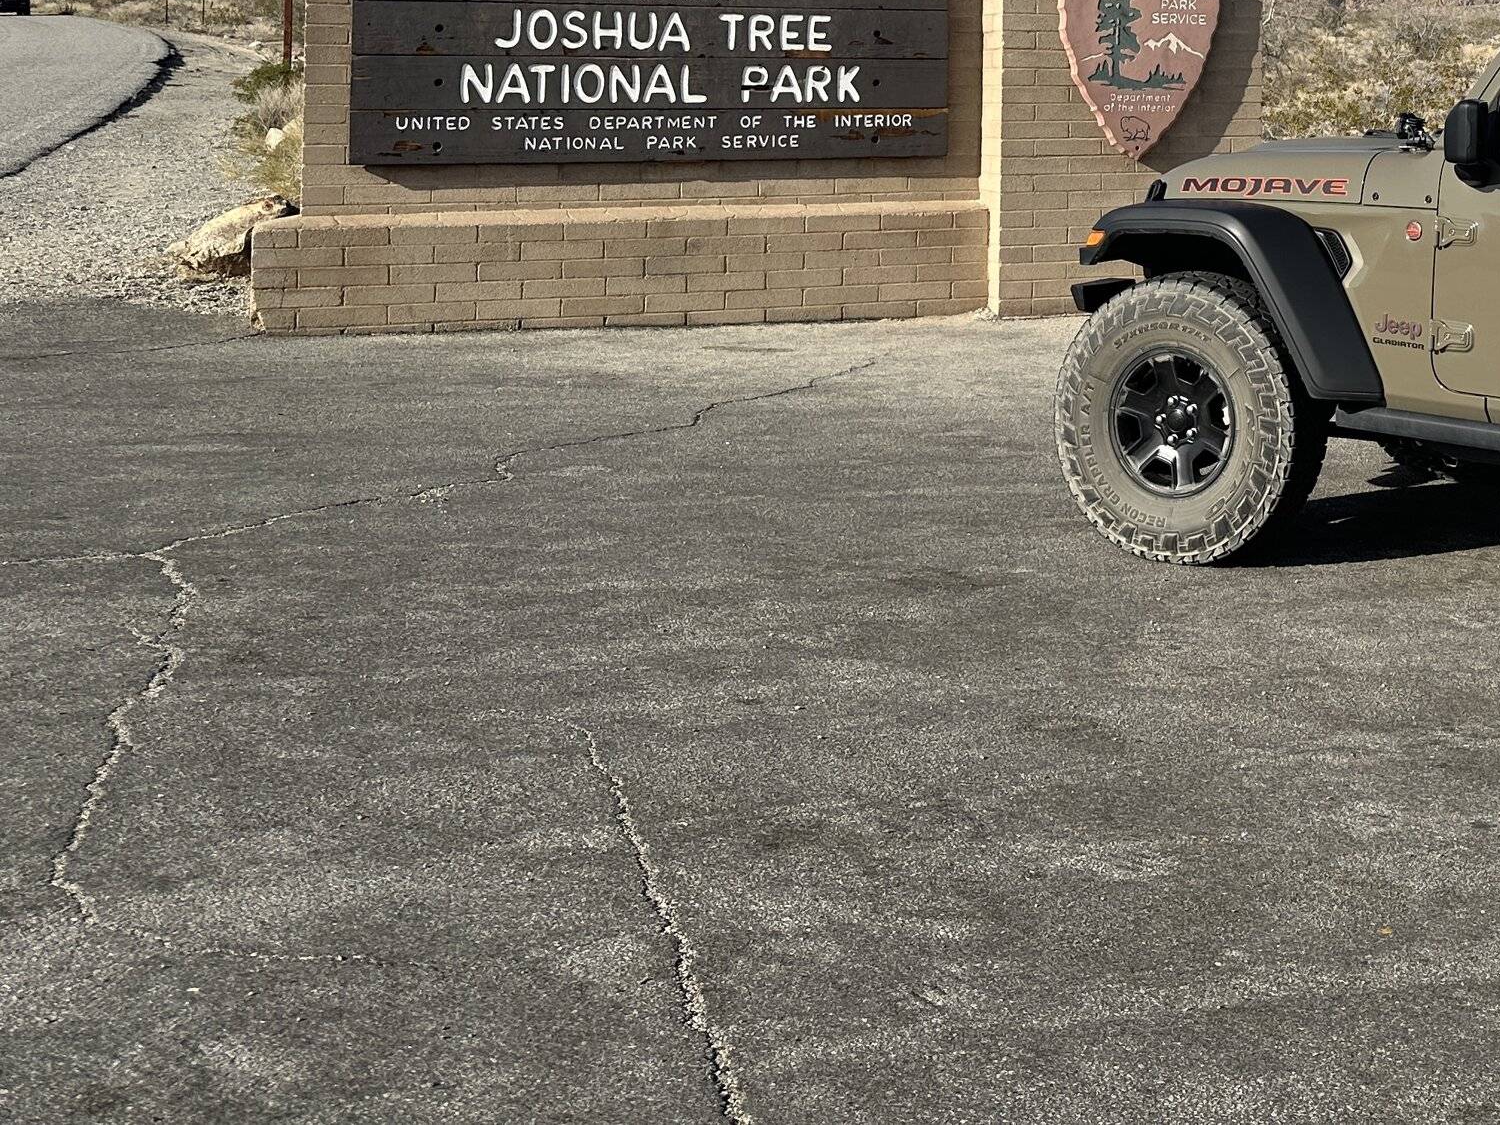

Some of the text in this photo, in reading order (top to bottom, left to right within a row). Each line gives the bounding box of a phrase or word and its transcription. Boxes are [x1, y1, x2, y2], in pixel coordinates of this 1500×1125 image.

[1151, 13, 1207, 25] SERVICE
[494, 9, 832, 52] JOSHUA TREE
[460, 63, 860, 104] NATIONAL PARK
[1103, 102, 1115, 112] of
[1118, 103, 1134, 112] the
[1110, 93, 1171, 103] Department
[395, 114, 912, 131] UNITED STATES DEPARTMENT OF THE INTERIOR
[524, 135, 799, 151] NATIONAL PARK SERVICE
[1181, 176, 1350, 196] MOJAVE
[1375, 313, 1423, 341] Jeep
[1372, 336, 1425, 350] GLADIATOR
[1080, 424, 1121, 505] GRAPPLER
[1120, 502, 1168, 528] RECON
